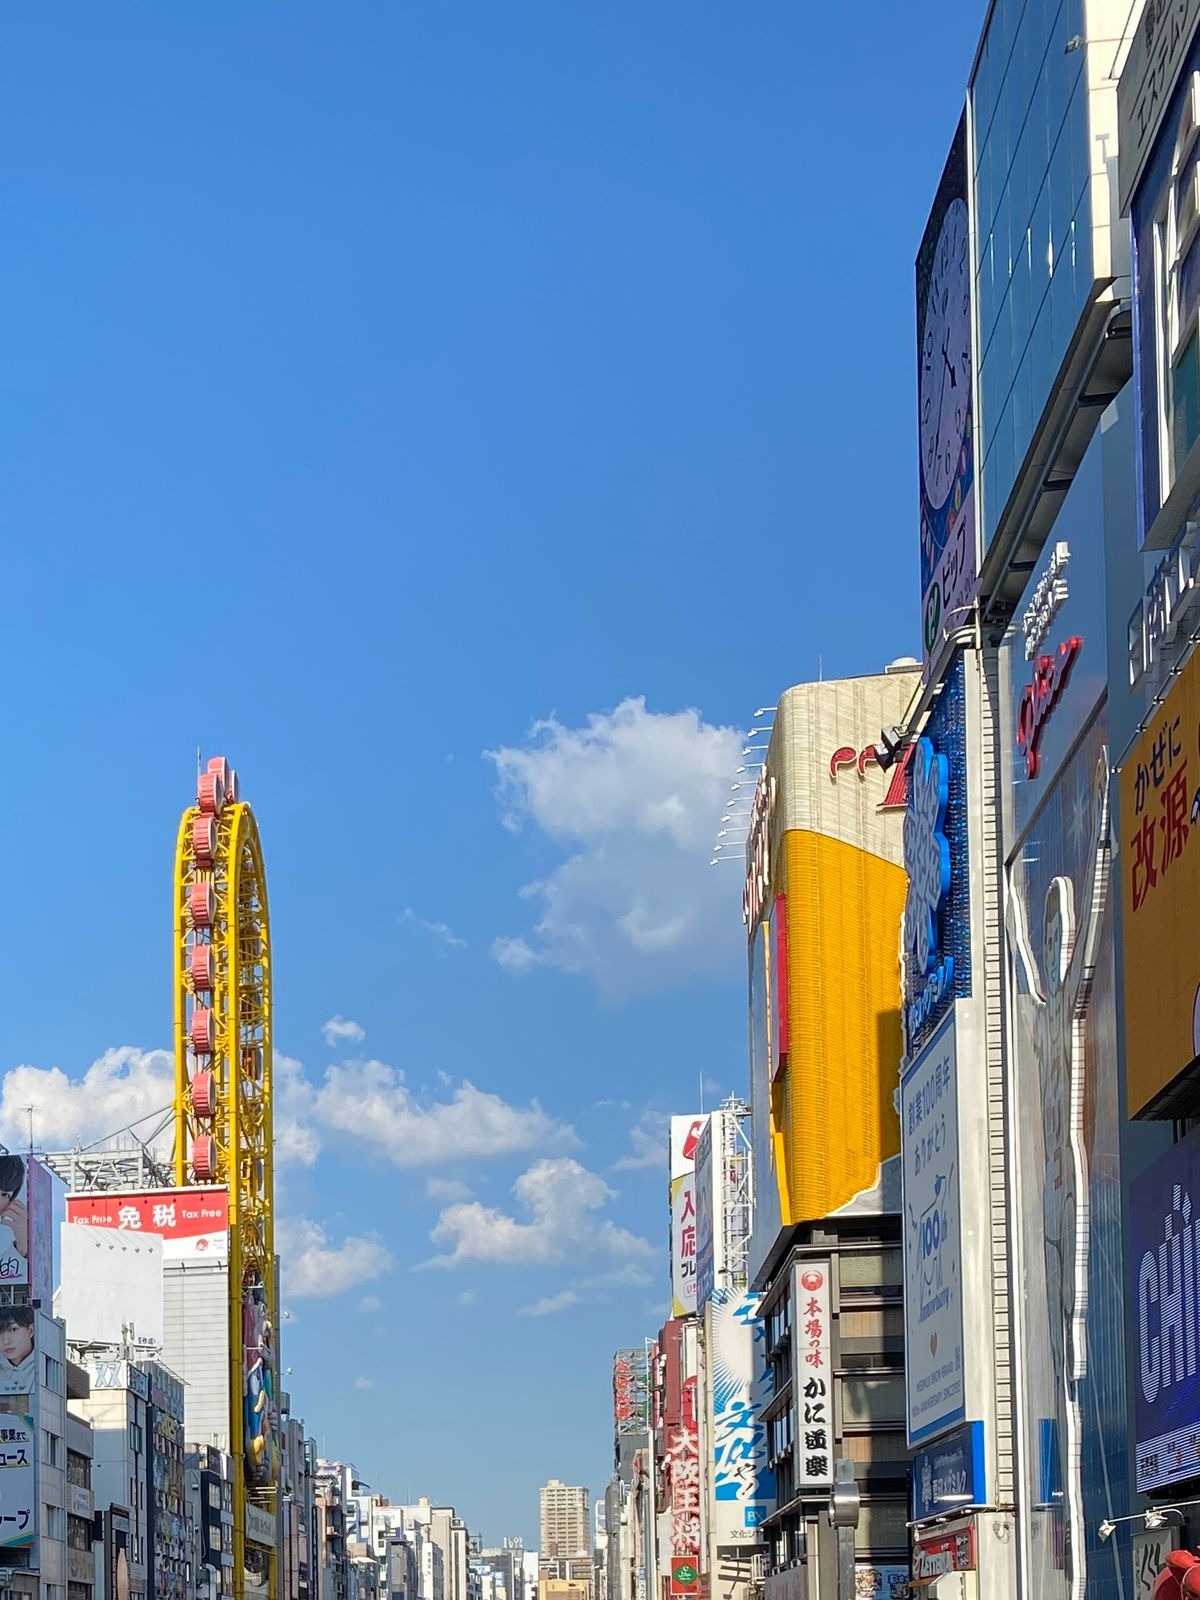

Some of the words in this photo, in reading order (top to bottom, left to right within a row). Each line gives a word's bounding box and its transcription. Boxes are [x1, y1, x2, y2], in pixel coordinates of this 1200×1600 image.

[1134, 714, 1182, 816] かぜに
[1130, 757, 1190, 913] 改源
[118, 1203, 177, 1230] 免税
[181, 1209, 199, 1220] Tax
[200, 1208, 223, 1218] Free
[803, 1296, 825, 1369] 本場の味
[803, 1375, 828, 1478] かに道楽
[670, 1426, 701, 1552] 大阪王将
